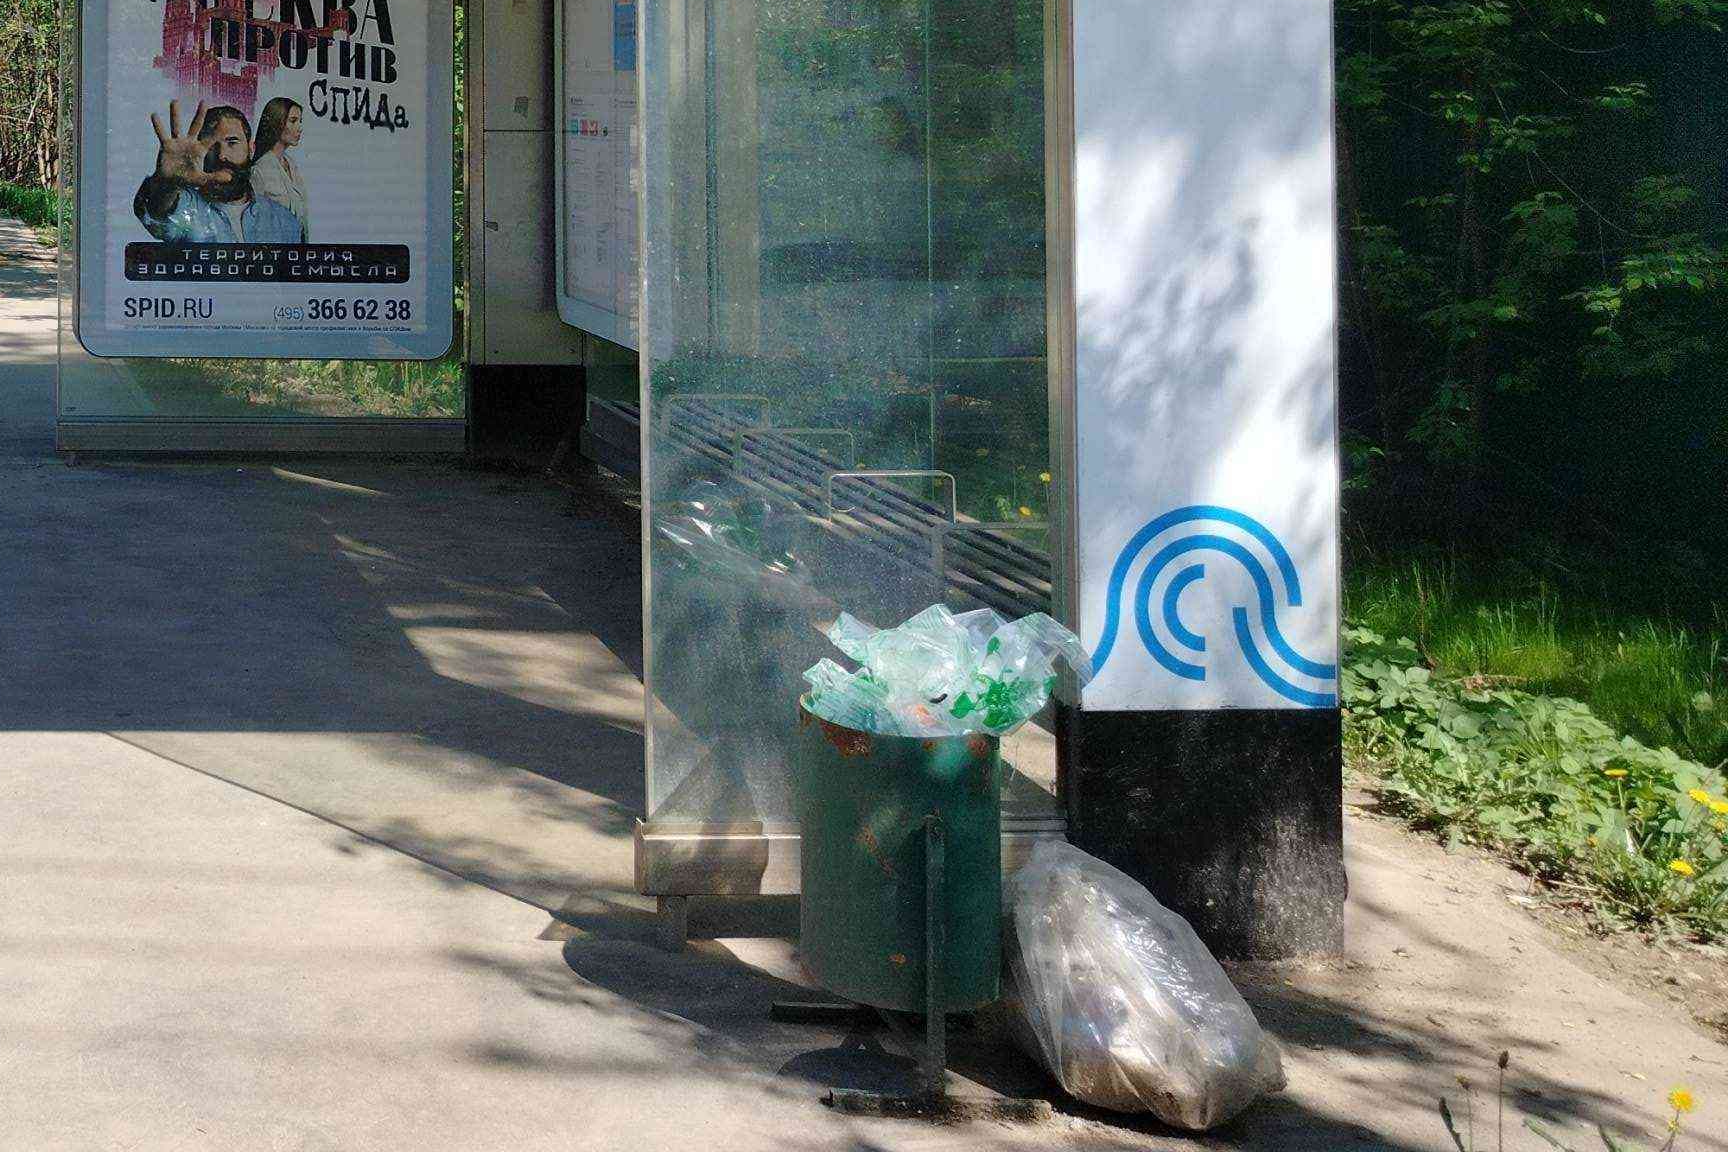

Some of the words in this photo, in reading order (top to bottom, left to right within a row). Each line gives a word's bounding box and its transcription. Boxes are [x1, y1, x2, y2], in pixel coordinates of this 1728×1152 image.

[210, 17, 398, 84] ПРОТИВ
[182, 249, 353, 262] ТЕРРИТОРИЯ
[137, 263, 274, 276] ЗДРАВОГО
[291, 264, 397, 277] СМЫСЛА
[123, 297, 213, 319] SPID.RU
[273, 306, 305, 322] (495)
[308, 298, 347, 320] 366
[353, 299, 379, 320] 62
[384, 299, 411, 321] 38
